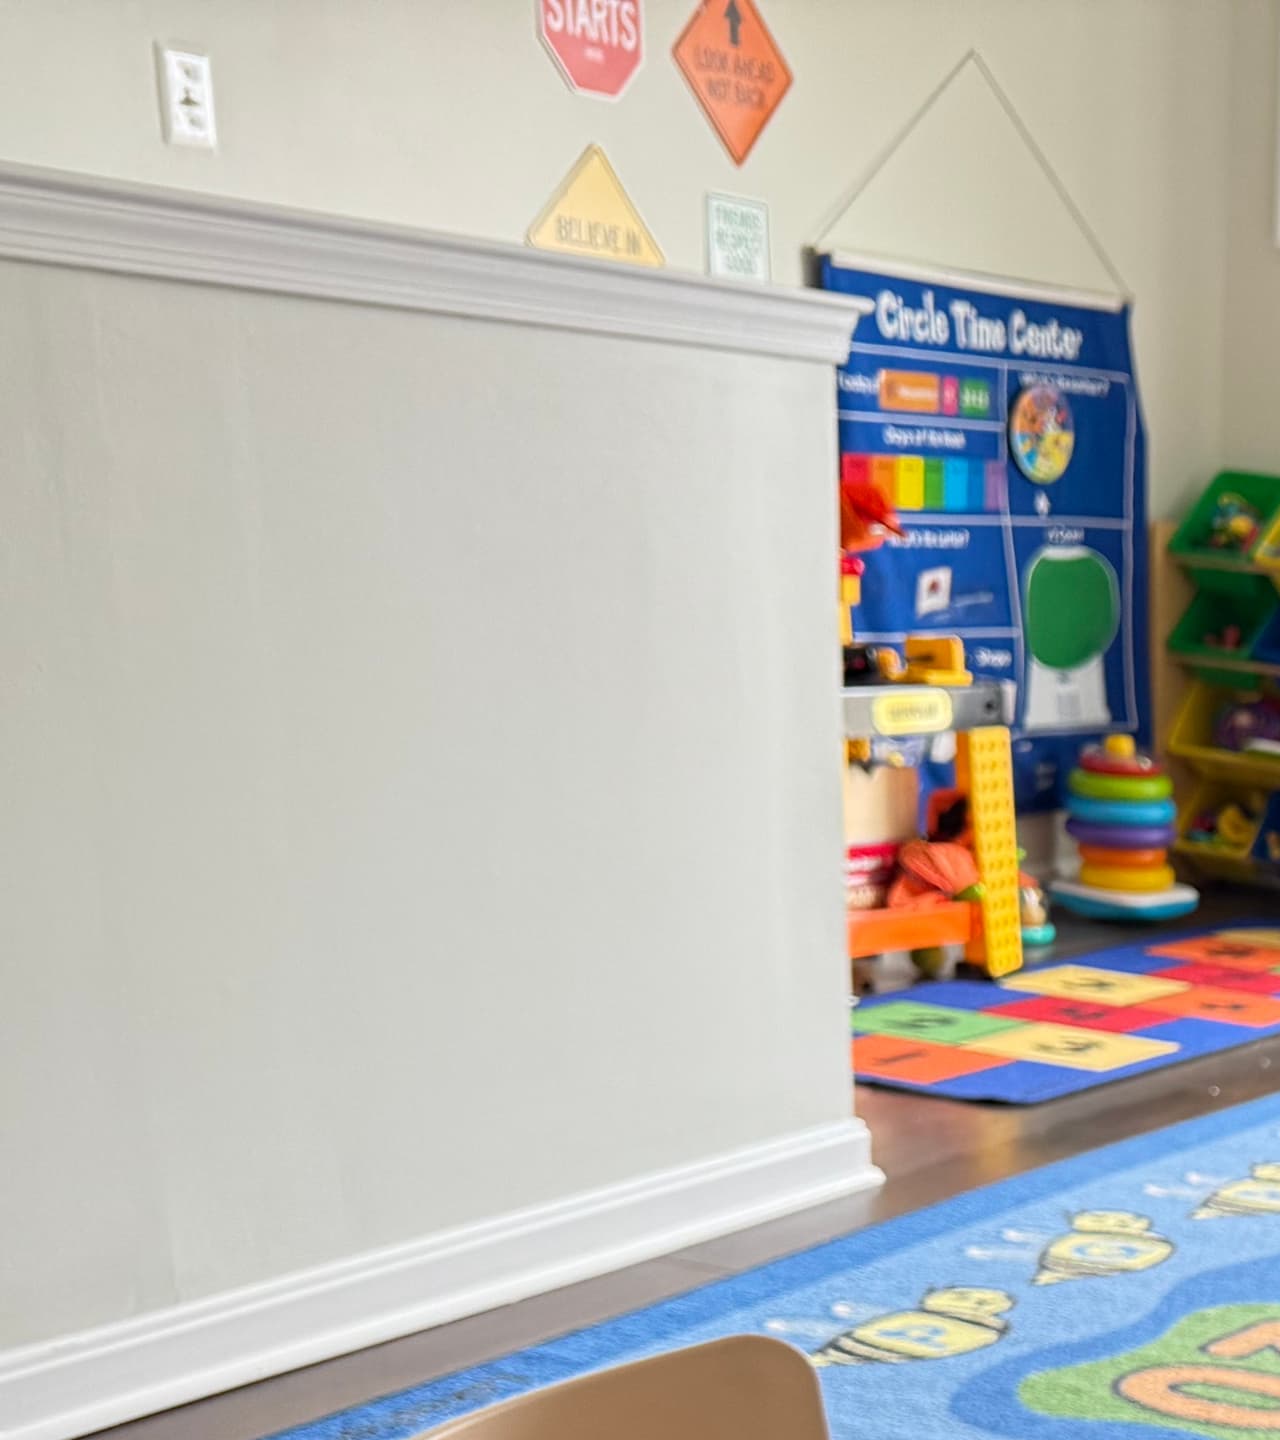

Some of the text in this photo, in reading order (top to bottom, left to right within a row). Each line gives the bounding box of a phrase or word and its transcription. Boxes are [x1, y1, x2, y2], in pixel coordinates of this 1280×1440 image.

[546, 0, 637, 51] STARTS
[876, 290, 1083, 360] Circle Time Center
